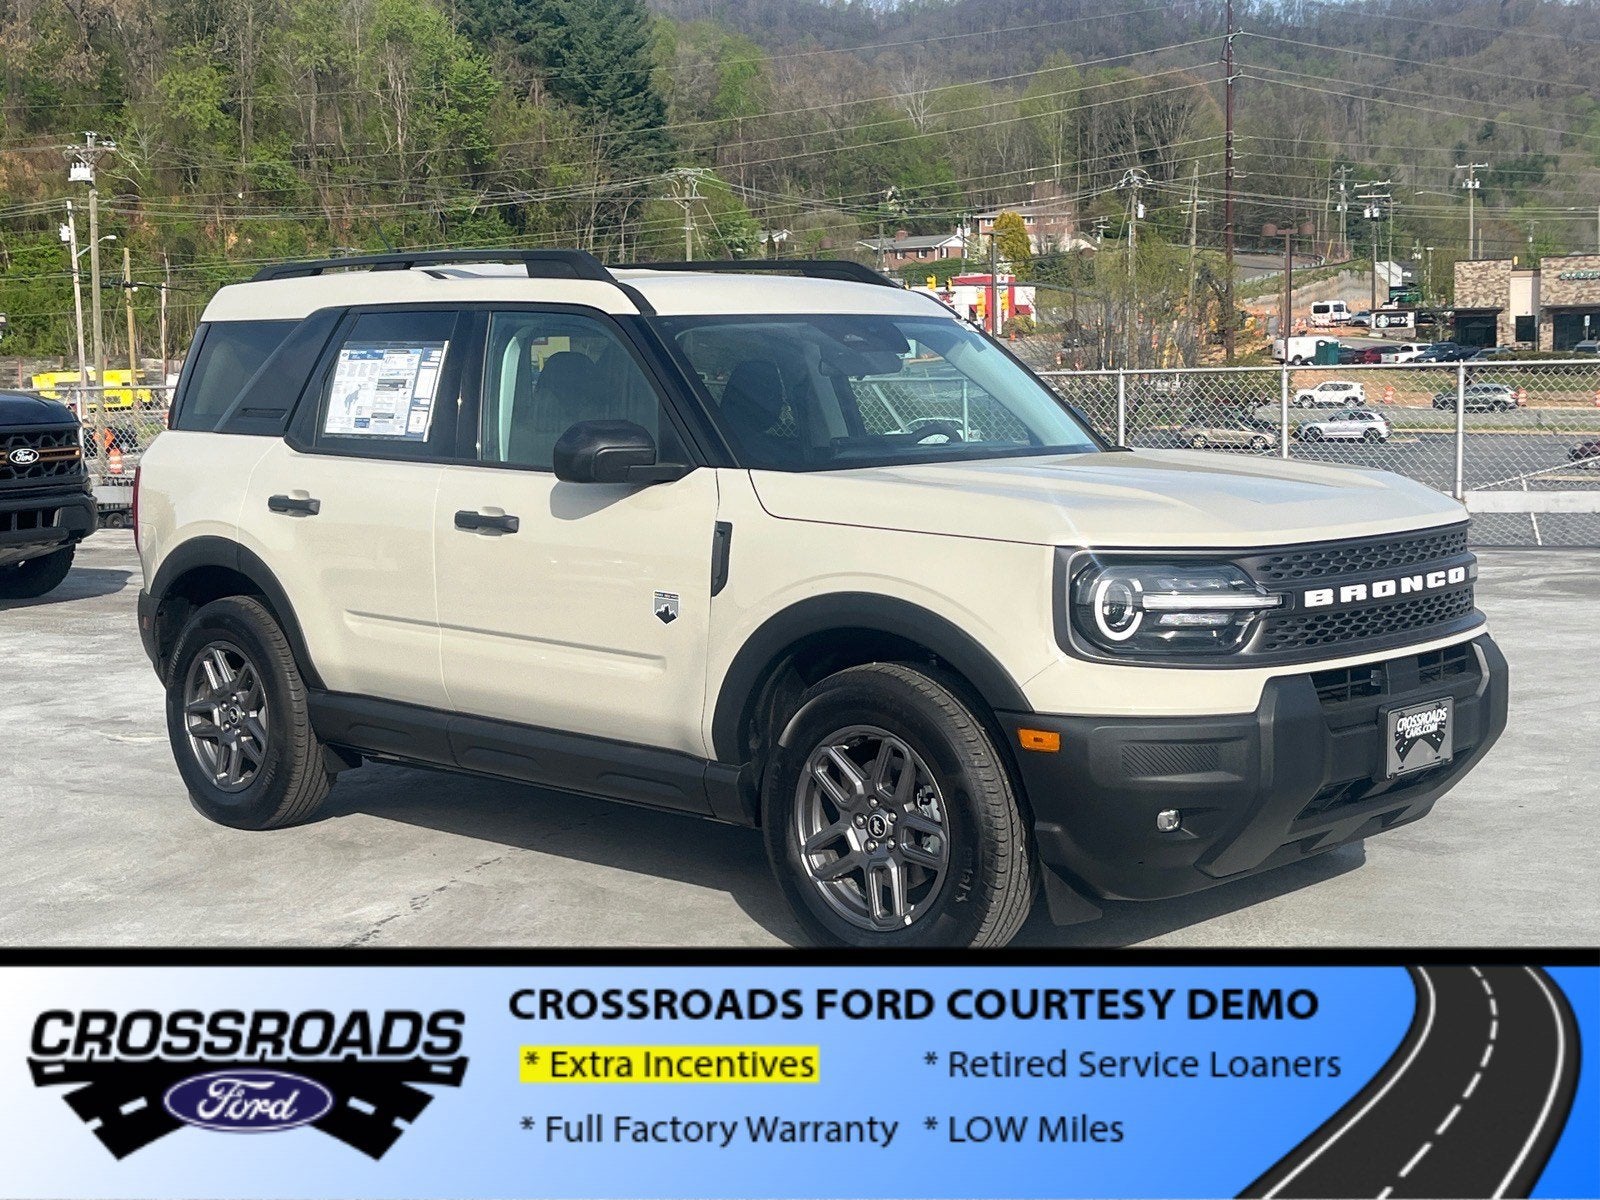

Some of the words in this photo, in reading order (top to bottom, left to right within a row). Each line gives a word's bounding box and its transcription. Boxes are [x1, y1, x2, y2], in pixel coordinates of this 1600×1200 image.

[15, 449, 34, 462] Ford
[1304, 566, 1466, 608] BRONCO
[1397, 707, 1448, 732] CROSSROADS
[1405, 722, 1438, 739] CARS.COM
